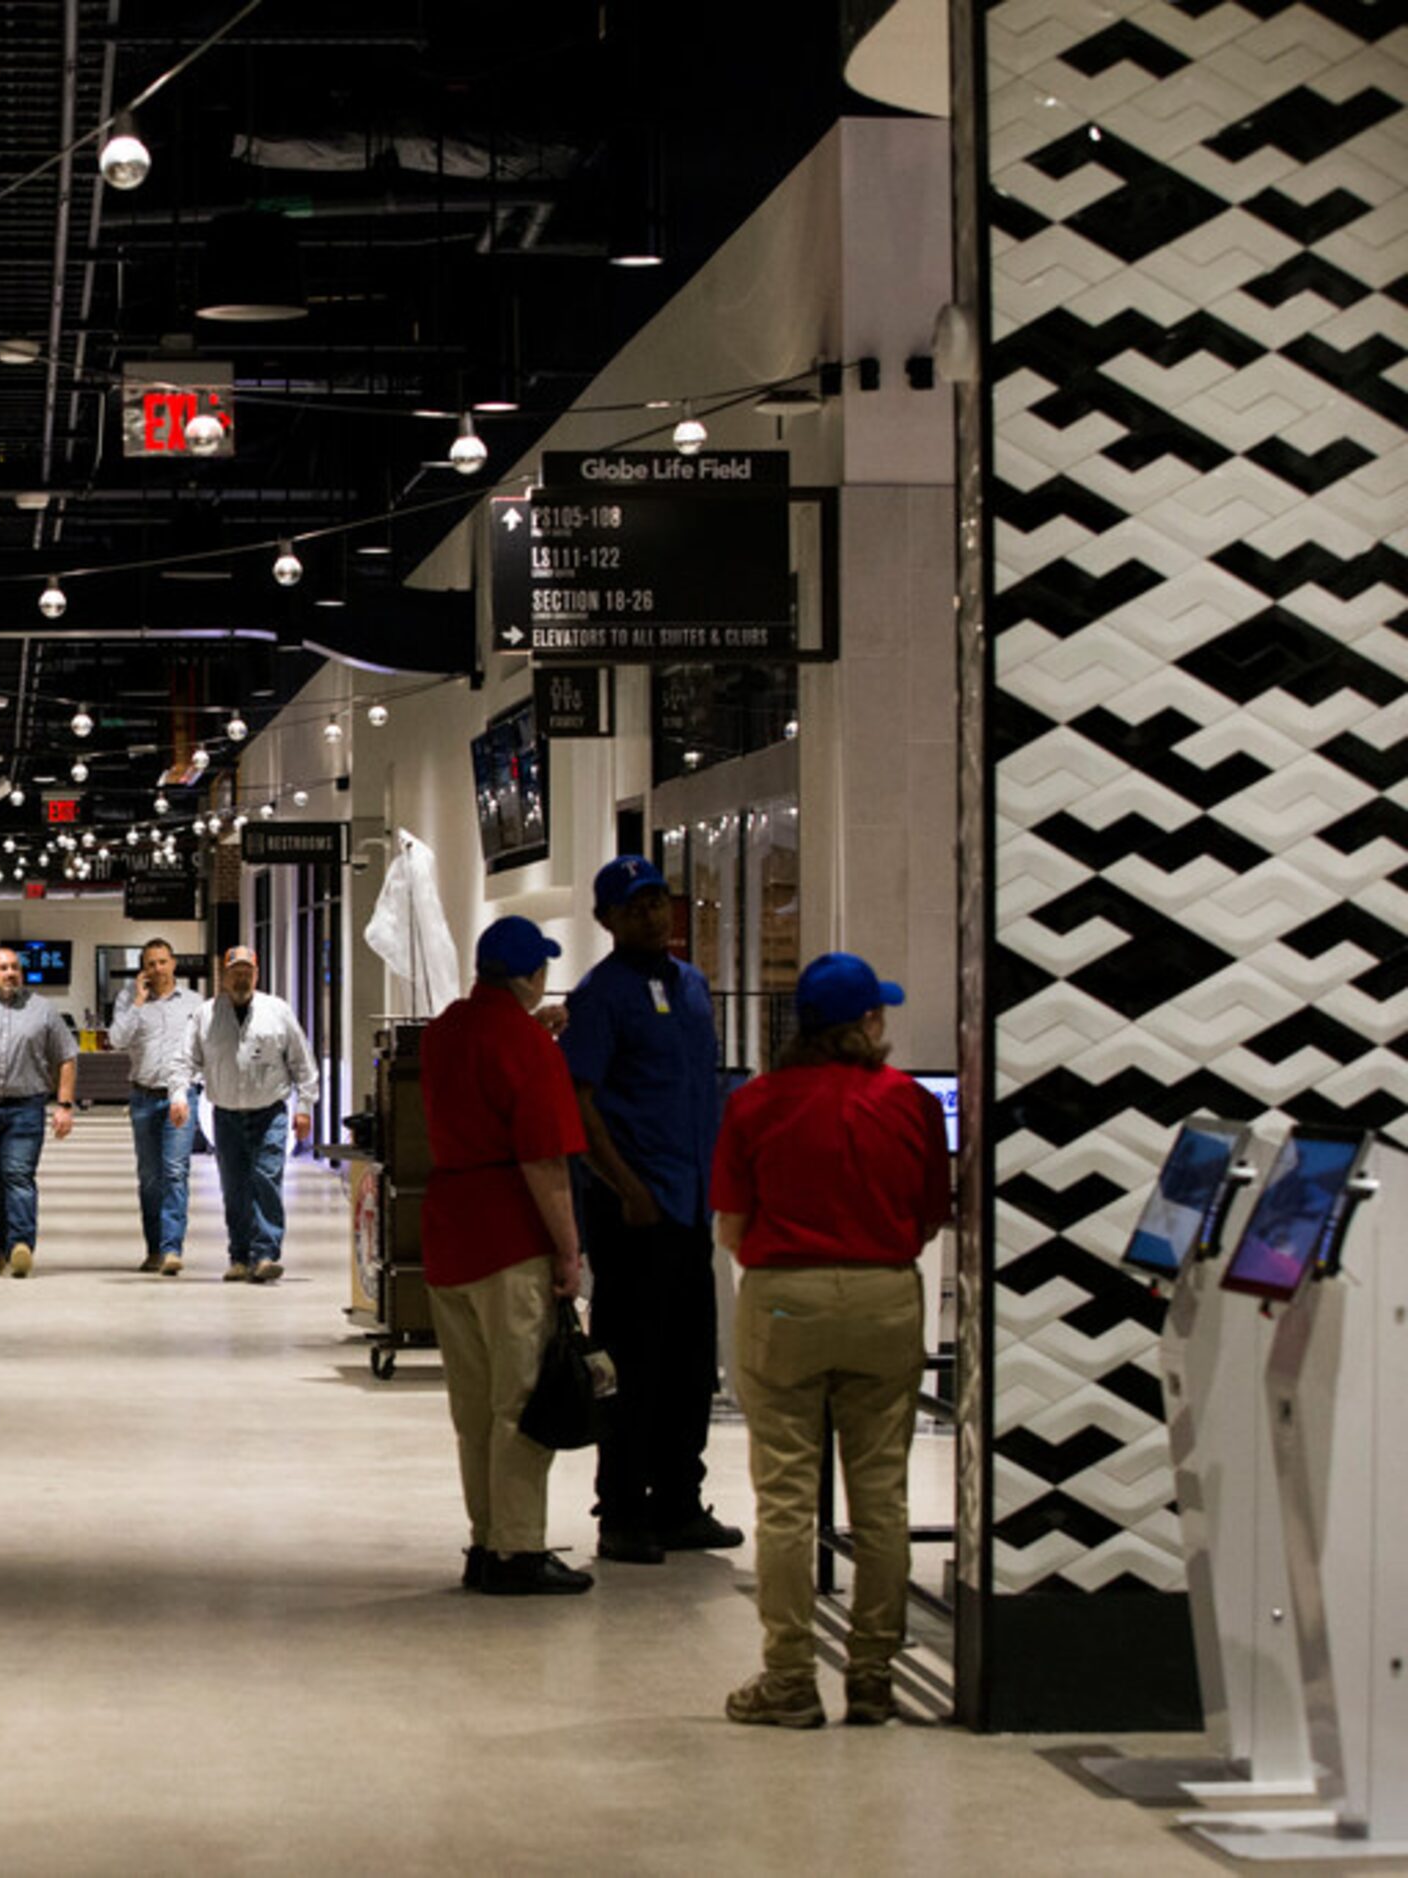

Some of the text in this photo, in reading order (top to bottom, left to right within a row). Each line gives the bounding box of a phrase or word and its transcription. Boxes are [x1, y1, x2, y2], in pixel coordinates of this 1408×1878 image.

[144, 391, 220, 450] EXI
[581, 458, 752, 480] Globe Life Field
[532, 547, 620, 569] LS111-122
[532, 590, 653, 611] SECTION 18-26
[532, 628, 605, 647] ELEVATORS
[610, 628, 628, 646] TO
[632, 628, 655, 646] ALL
[659, 628, 706, 646] SUITES
[725, 628, 768, 646] CLUBS
[267, 834, 335, 851] RESTROOMS
[620, 860, 640, 879] T
